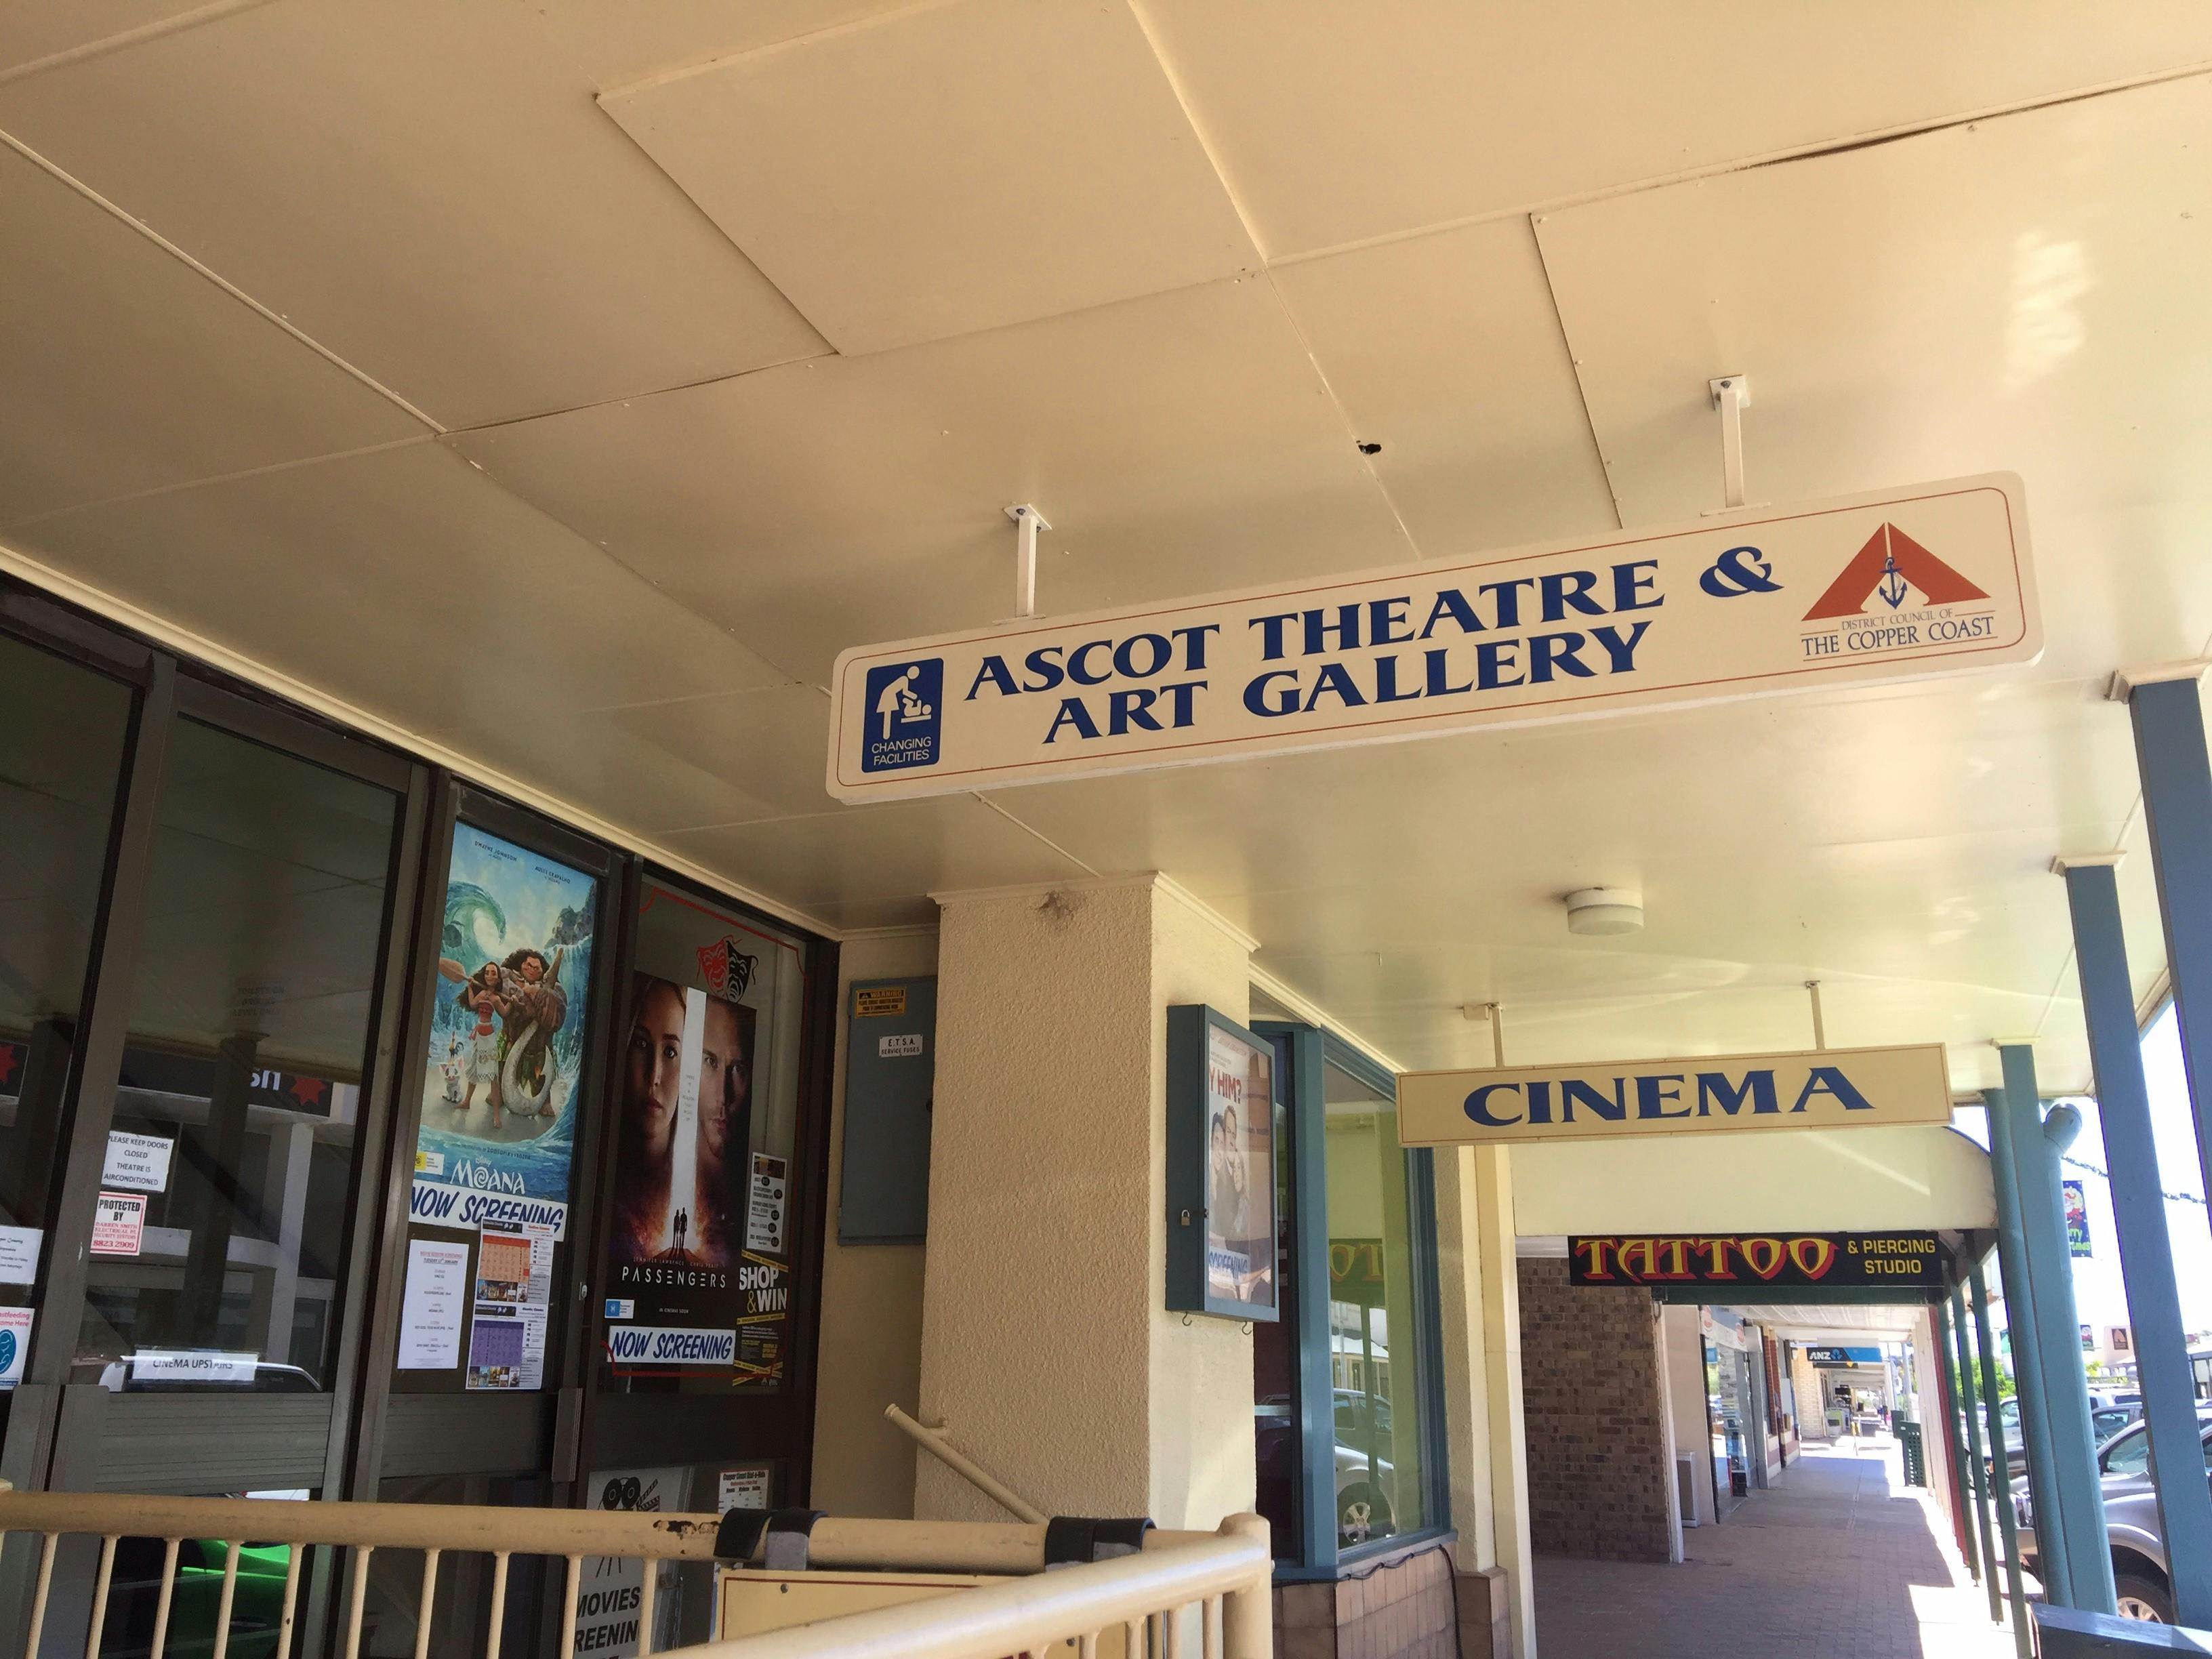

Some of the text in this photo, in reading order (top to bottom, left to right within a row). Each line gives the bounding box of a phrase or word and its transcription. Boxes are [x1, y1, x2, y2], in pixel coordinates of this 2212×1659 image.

[964, 546, 1784, 701] ASCOT THEATRE &
[1841, 608, 1954, 630] DISTRICT COUNCIL OF
[1801, 616, 1994, 656] THE COPPER COAST
[1043, 621, 1653, 744] ART GALLERY
[871, 736, 931, 754] CHANGING
[874, 749, 930, 766] FACILITIES
[1217, 1069, 1242, 1104] HIM?
[1463, 1067, 1876, 1126] CINEMA
[124, 1149, 148, 1158] CLOSED
[147, 1141, 169, 1149] DOORS
[117, 1162, 144, 1172] THEATRE
[450, 1159, 525, 1195] MOANA
[104, 1173, 159, 1185] AIRCONDITIONED
[98, 1199, 141, 1212] PROTECTED
[113, 1212, 124, 1221] BY
[1574, 1236, 1936, 1284] TATTOO & PIERCING
[1865, 1259, 1922, 1273] STUDIO
[621, 1266, 726, 1289] PASSENGERS
[739, 1266, 779, 1290] SHOP
[747, 1288, 787, 1313] & WIN
[613, 1331, 653, 1358] NOW
[653, 1333, 733, 1360] SCREENING
[1809, 1351, 1831, 1360] ANZ
[152, 1358, 189, 1368] CINEMA
[575, 1620, 639, 1652] REENIN
